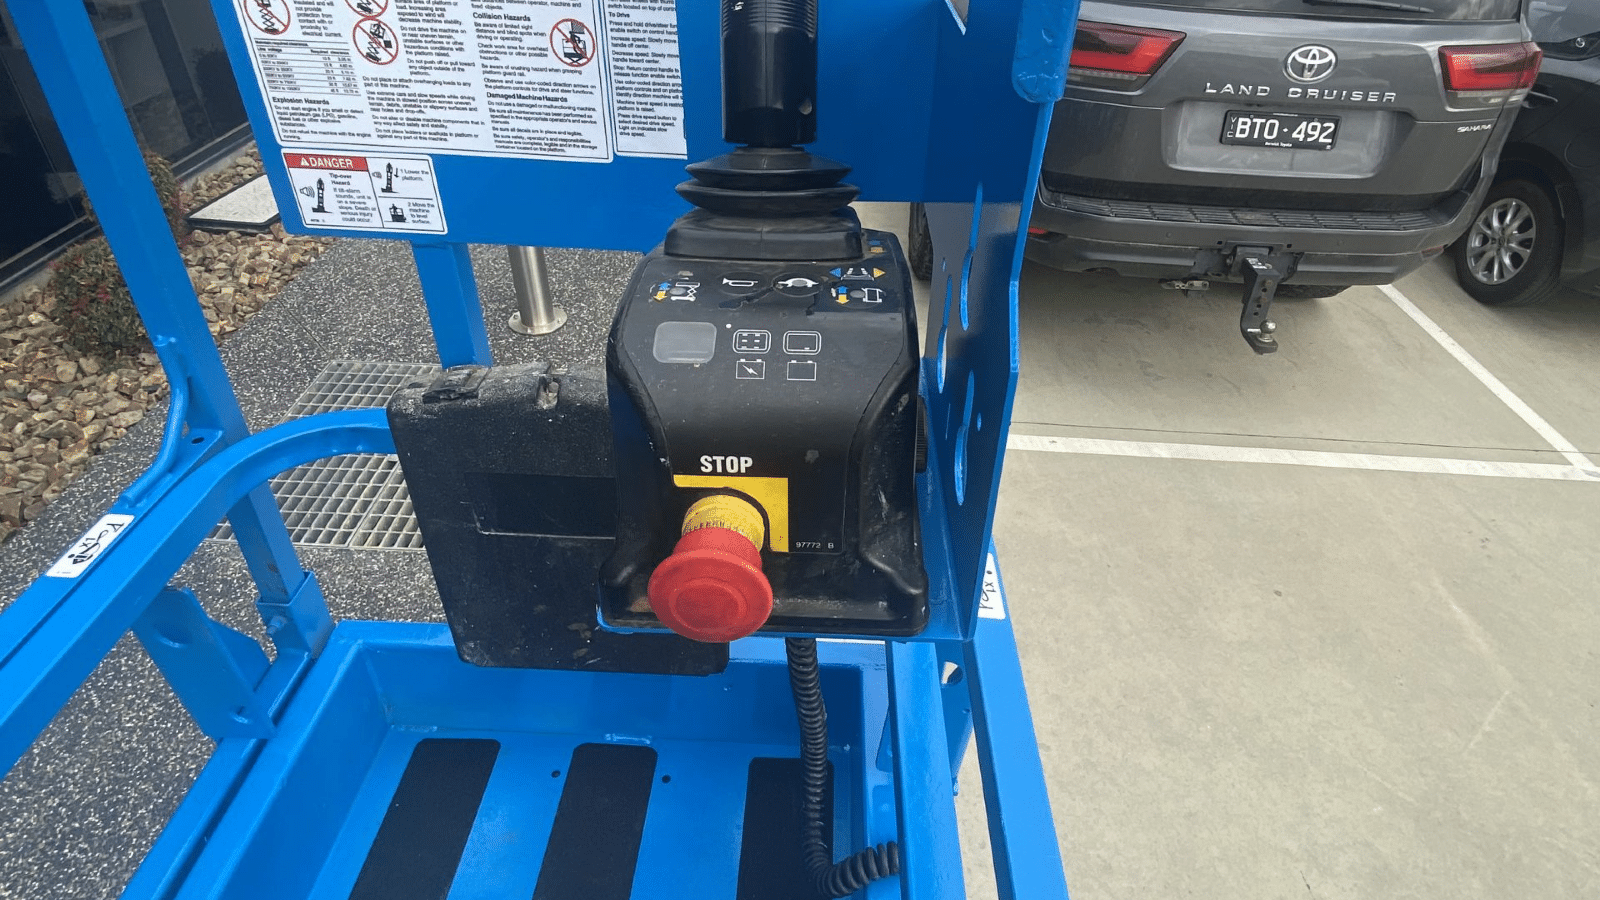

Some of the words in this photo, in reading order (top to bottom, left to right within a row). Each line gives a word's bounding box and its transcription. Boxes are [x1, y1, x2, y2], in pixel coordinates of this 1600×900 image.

[487, 92, 516, 101] Damaged
[1205, 82, 1270, 96] LAND
[1288, 87, 1396, 102] CRUISER
[272, 97, 303, 106] Explosion
[1457, 124, 1492, 133] SAHARA
[310, 157, 354, 169] DANGER
[700, 455, 753, 473] STOP
